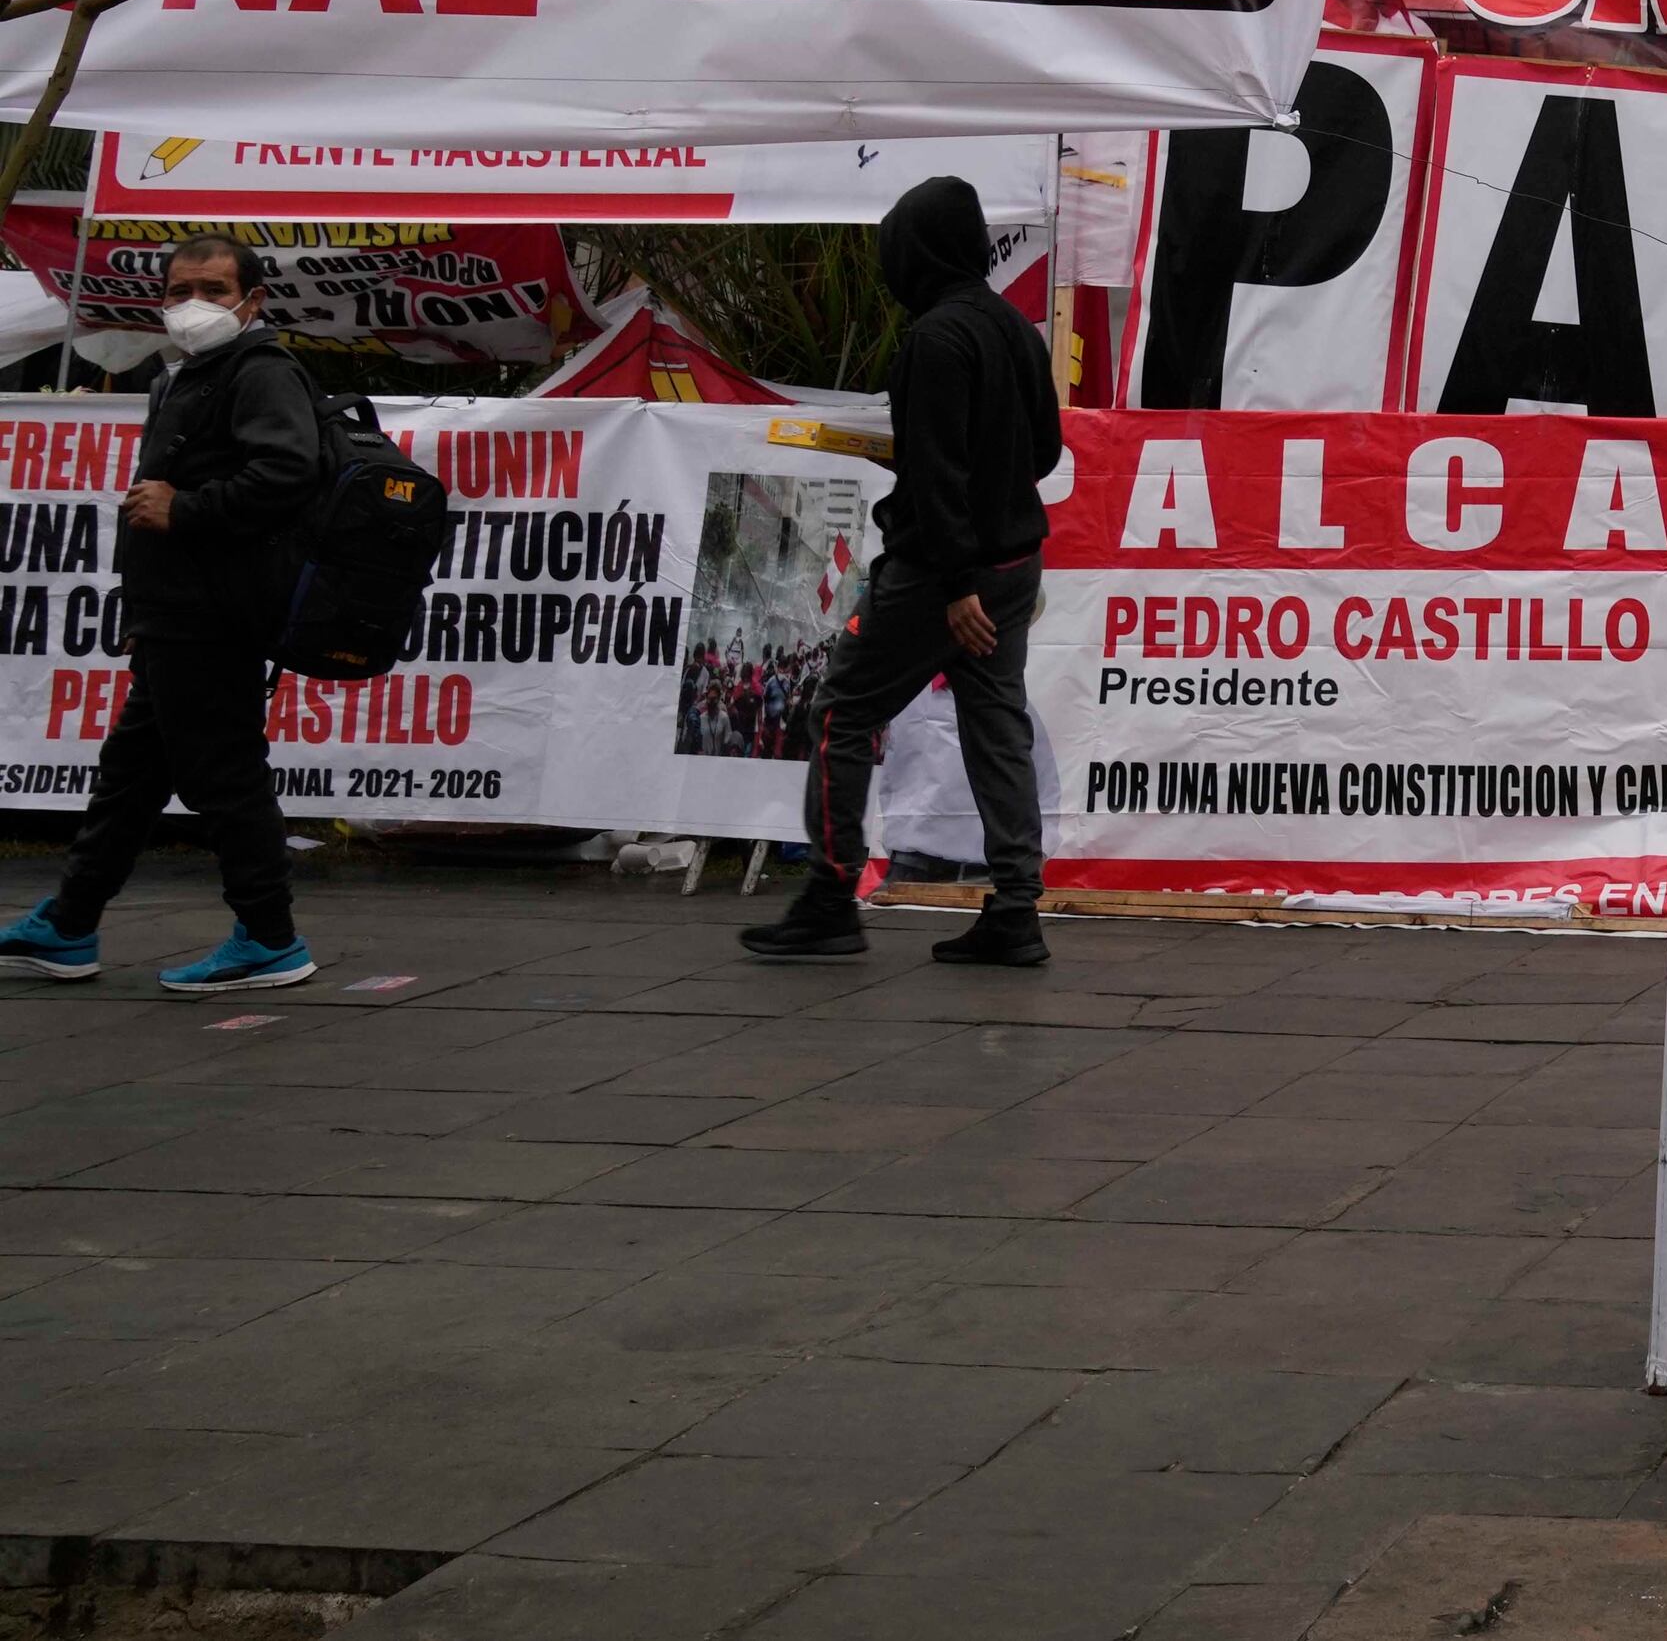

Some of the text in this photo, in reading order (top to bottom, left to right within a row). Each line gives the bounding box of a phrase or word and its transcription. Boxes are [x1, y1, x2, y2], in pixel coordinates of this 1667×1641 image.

[383, 476, 416, 503] CAT
[437, 430, 584, 499] JUNIN
[437, 499, 666, 584] TITUCIÓN
[401, 579, 683, 668] ORRUPCIÓN
[1102, 595, 1651, 663] PEDRO CASTILLO
[264, 672, 473, 746] ASTILLO
[1098, 666, 1339, 707] Presidente
[430, 769, 502, 799] 2026
[1086, 761, 1149, 814] POR
[1157, 762, 1217, 814] UNA
[1227, 762, 1329, 815] NUEVA
[1338, 762, 1577, 819] CONSTITUCION
[1587, 763, 1606, 816] Y
